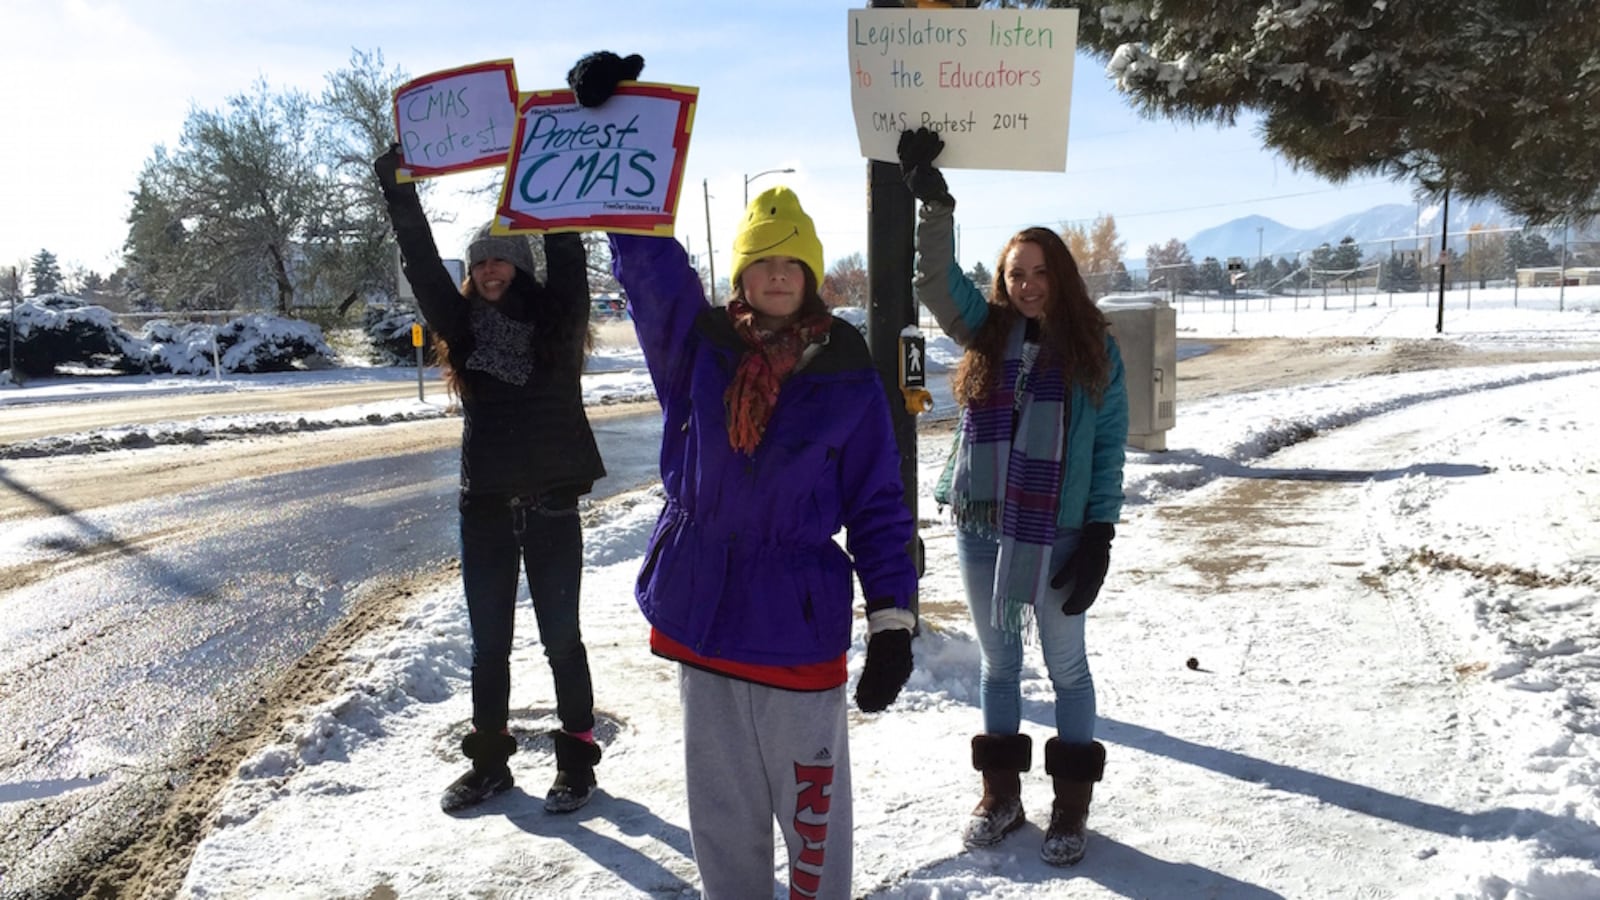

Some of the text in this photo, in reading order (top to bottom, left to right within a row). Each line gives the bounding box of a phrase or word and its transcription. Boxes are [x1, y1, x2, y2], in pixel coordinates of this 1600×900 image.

[855, 16, 1053, 56] Legislators listen
[856, 60, 1041, 89] to the Educators
[407, 86, 470, 122] CMAS
[872, 111, 1029, 133] CMAS Protest 2014
[403, 117, 496, 165] Protest
[521, 114, 639, 154] Protest
[519, 151, 657, 203] CMAS
